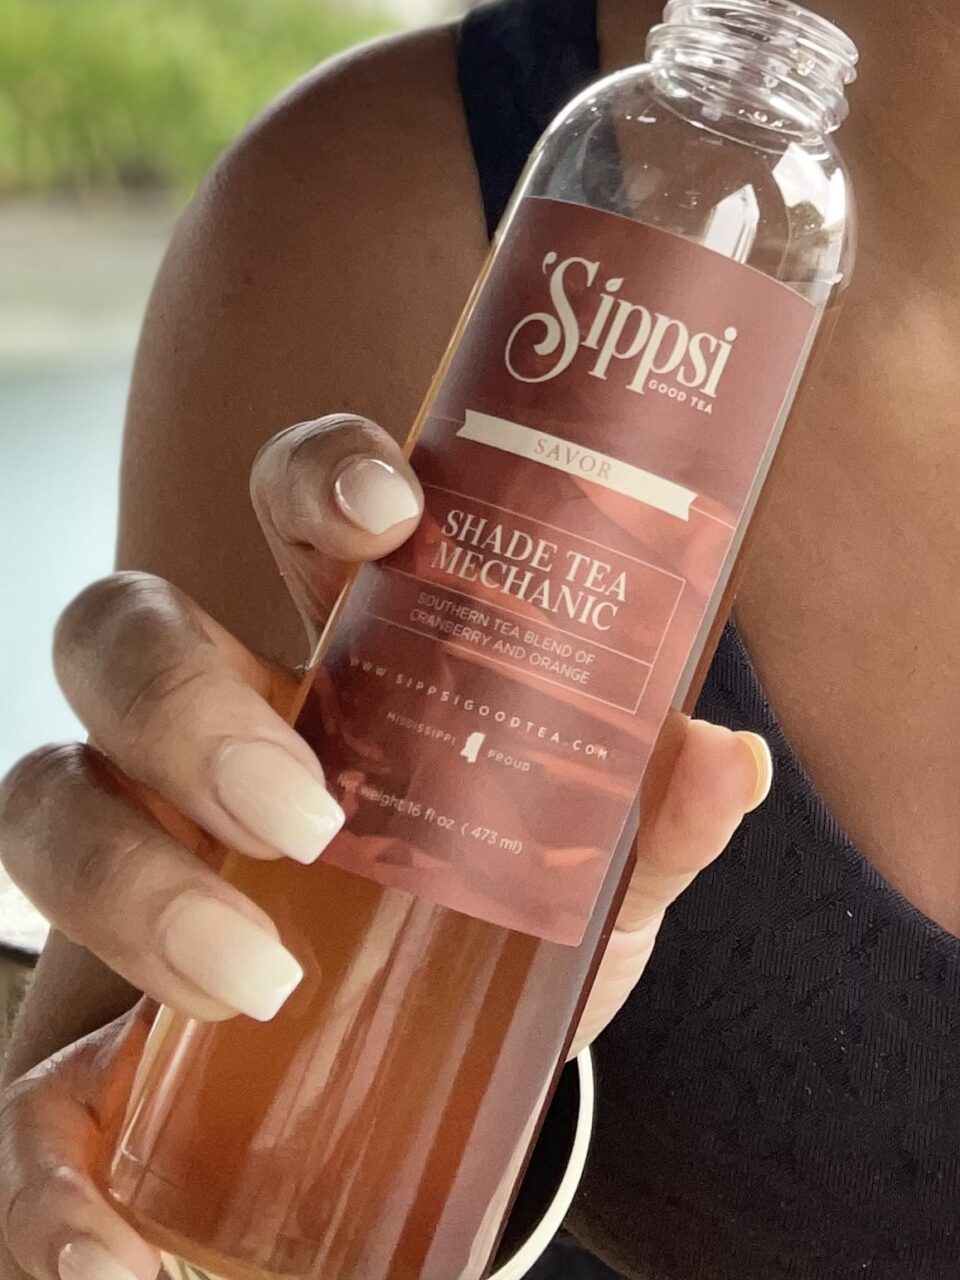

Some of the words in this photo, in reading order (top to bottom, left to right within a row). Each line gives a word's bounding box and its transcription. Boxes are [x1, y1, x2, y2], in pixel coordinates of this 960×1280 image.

[648, 379, 686, 402] GOOD
[690, 396, 713, 414] TEA
[534, 438, 612, 480] SAVOR
[431, 542, 618, 631] MECHANIC
[441, 509, 557, 571] SHADE
[565, 550, 628, 602] TEA
[409, 608, 491, 646] CRANBERRY
[493, 640, 526, 660] AND
[529, 652, 591, 684] ORANGE
[417, 592, 490, 627] SOUTHERN
[494, 619, 519, 638] TEA
[524, 630, 572, 658] BLEND
[575, 650, 596, 665] OF
[487, 748, 532, 772] PROUD
[407, 801, 421, 817] 16
[437, 815, 456, 830] oz
[471, 826, 498, 844] 473
[499, 838, 523, 855] ml)
